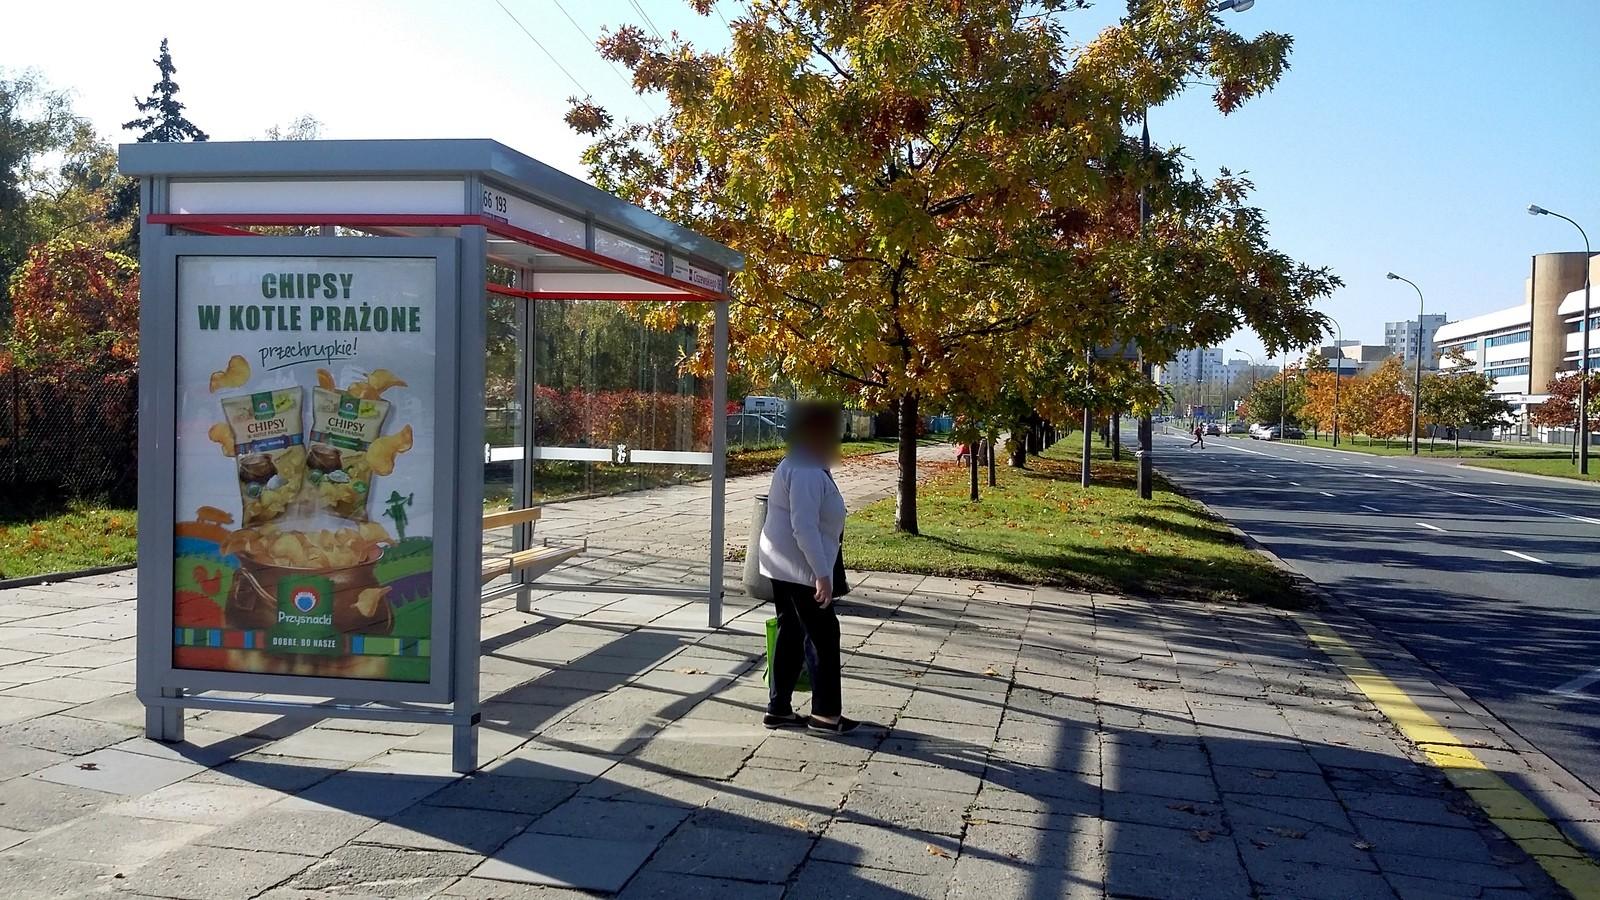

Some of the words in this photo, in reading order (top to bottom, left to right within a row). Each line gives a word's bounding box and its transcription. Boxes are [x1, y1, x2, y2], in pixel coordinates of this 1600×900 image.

[484, 190, 493, 209] 66
[495, 195, 507, 214] 193
[261, 272, 353, 299] CHIPSY
[198, 305, 221, 331] W
[229, 305, 302, 331] KOTLE
[310, 302, 421, 332] PRAŻONE
[258, 336, 358, 368] przechrupkie!
[247, 418, 286, 434] CHIPSY
[327, 417, 365, 432] CHIPSY
[278, 610, 332, 626] Przysnacki
[300, 638, 311, 647] BO
[313, 639, 337, 648] NASZE
